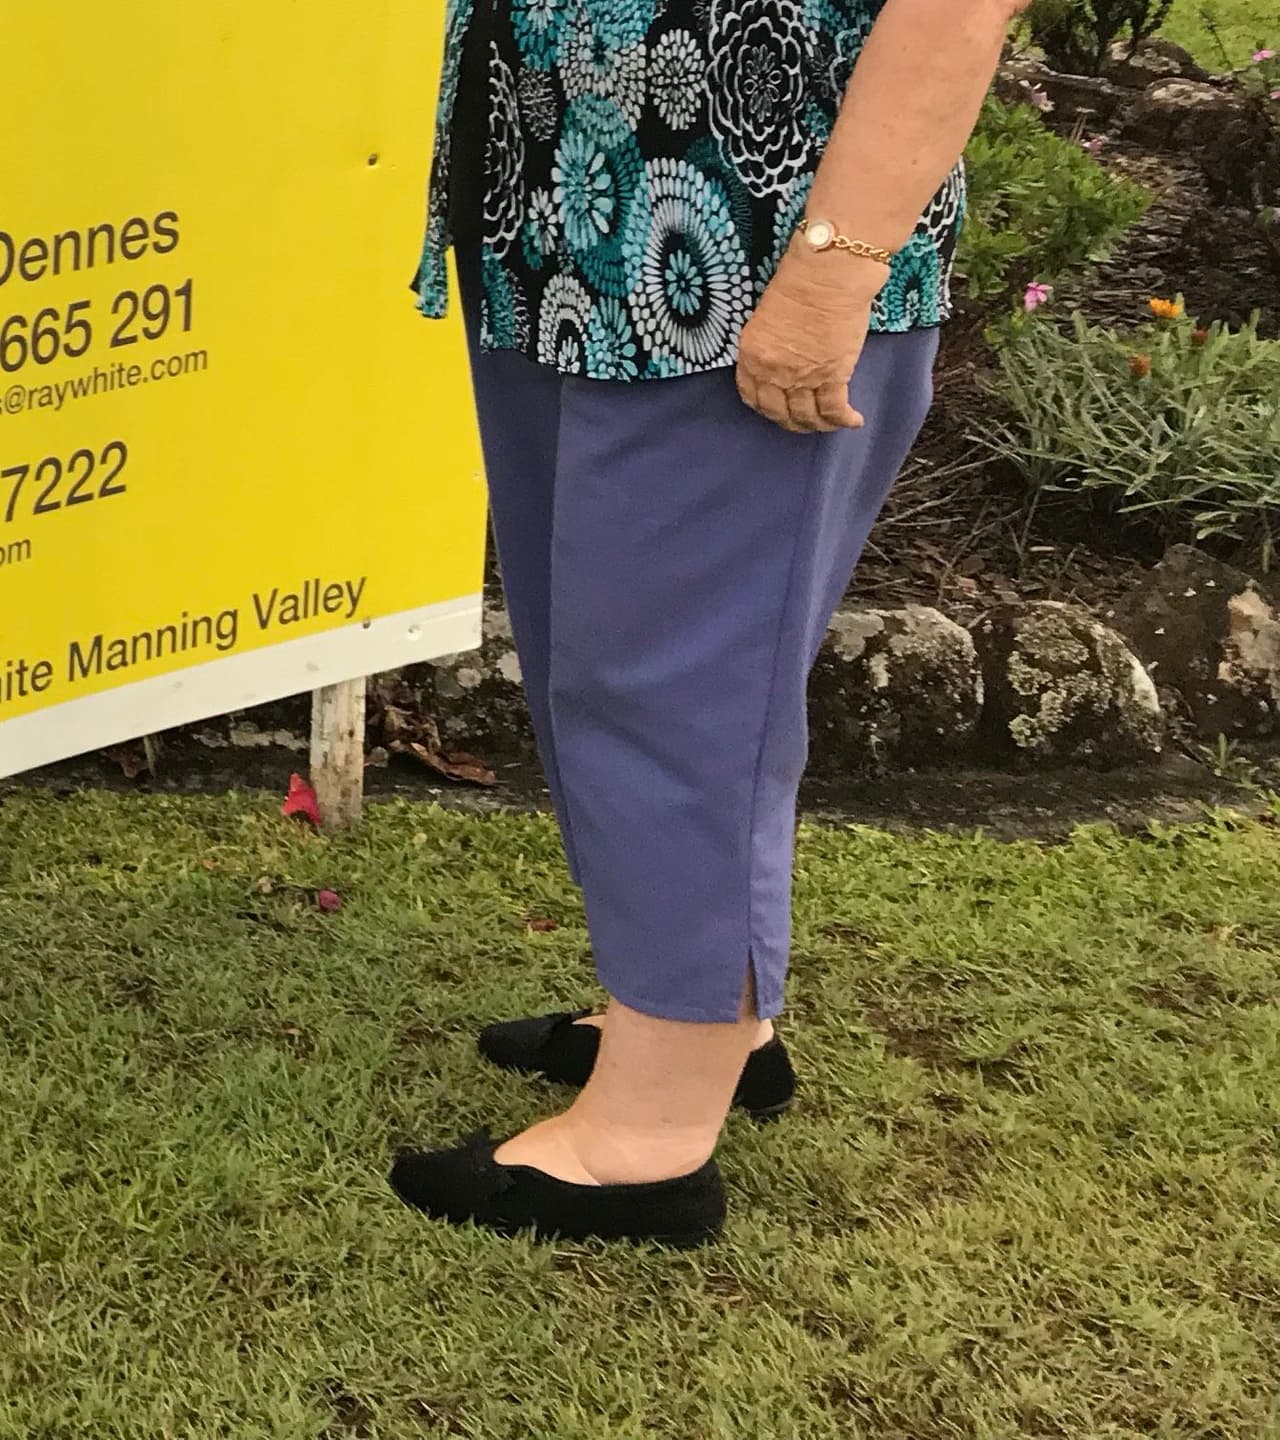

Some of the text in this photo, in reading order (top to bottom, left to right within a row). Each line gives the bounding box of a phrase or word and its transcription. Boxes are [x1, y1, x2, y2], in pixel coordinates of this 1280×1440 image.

[110, 279, 194, 346] 291
[0, 440, 127, 522] 7222
[68, 607, 238, 682] Manning
[252, 578, 367, 631] Valley
